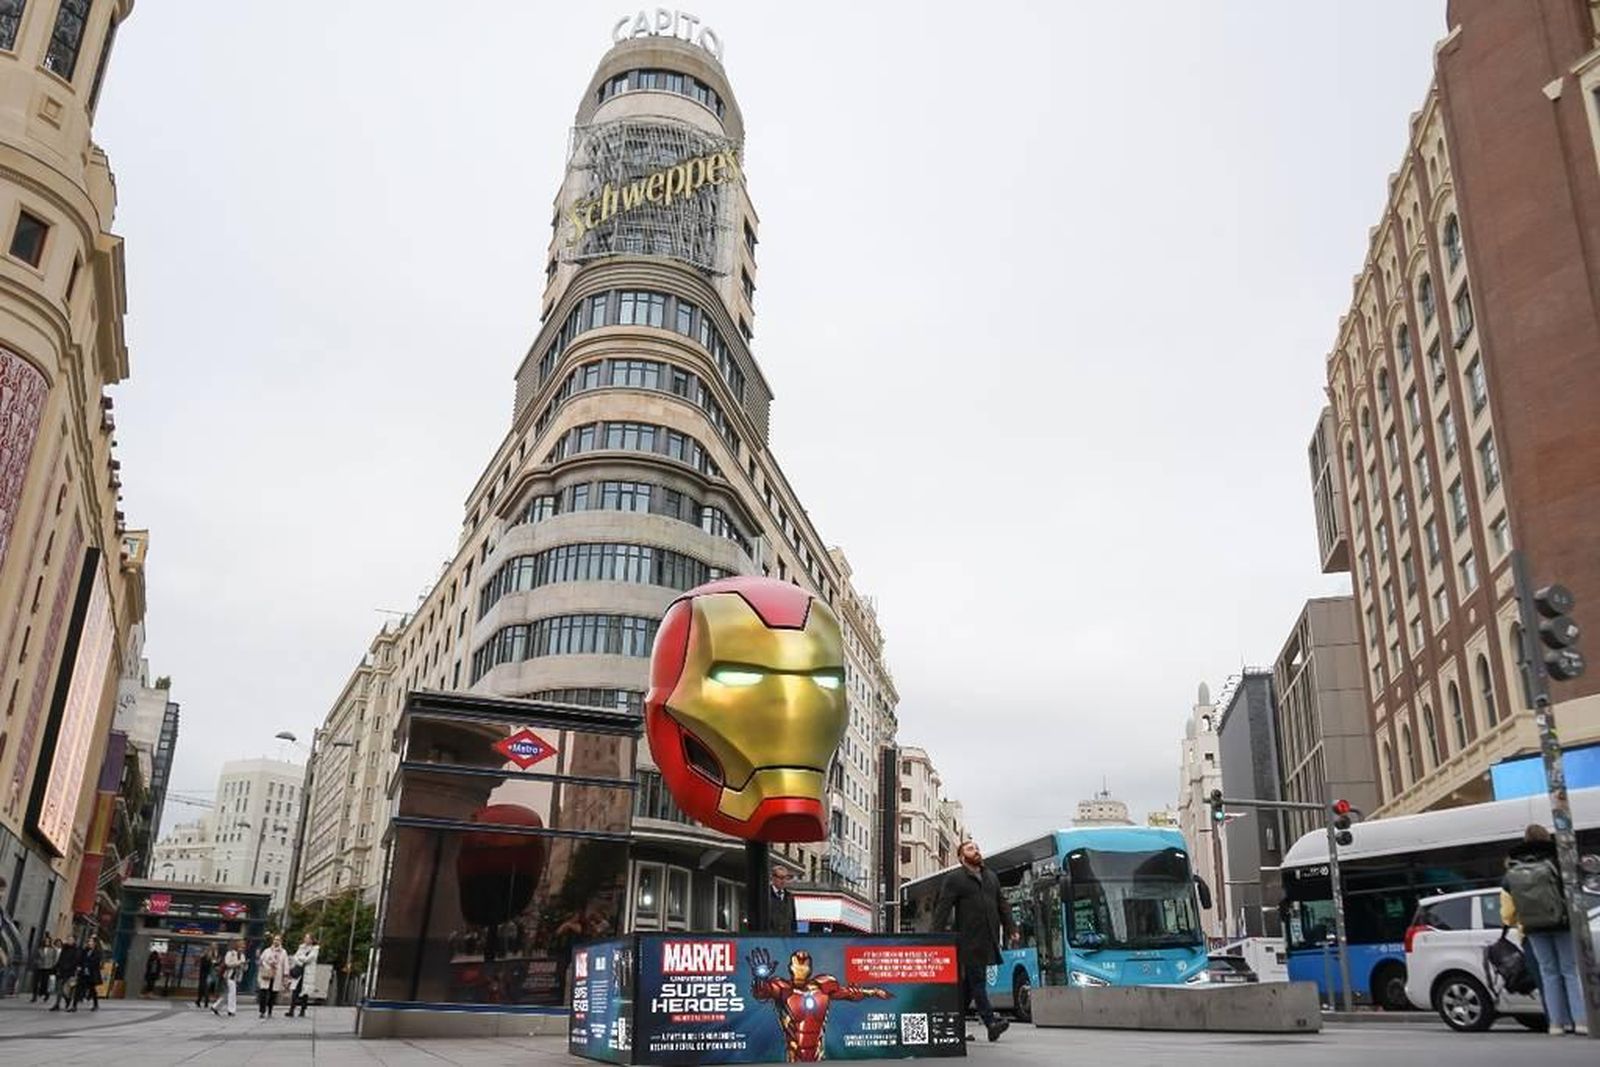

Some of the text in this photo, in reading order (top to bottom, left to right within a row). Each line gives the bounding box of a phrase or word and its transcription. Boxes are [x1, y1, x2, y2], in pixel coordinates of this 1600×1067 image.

[568, 149, 739, 242] Schweppes
[511, 743, 539, 755] Metro
[663, 943, 734, 972] MARVEL
[670, 975, 728, 983] UNIVERSE OF
[660, 983, 737, 998] SUPER
[651, 998, 745, 1013] HEROES
